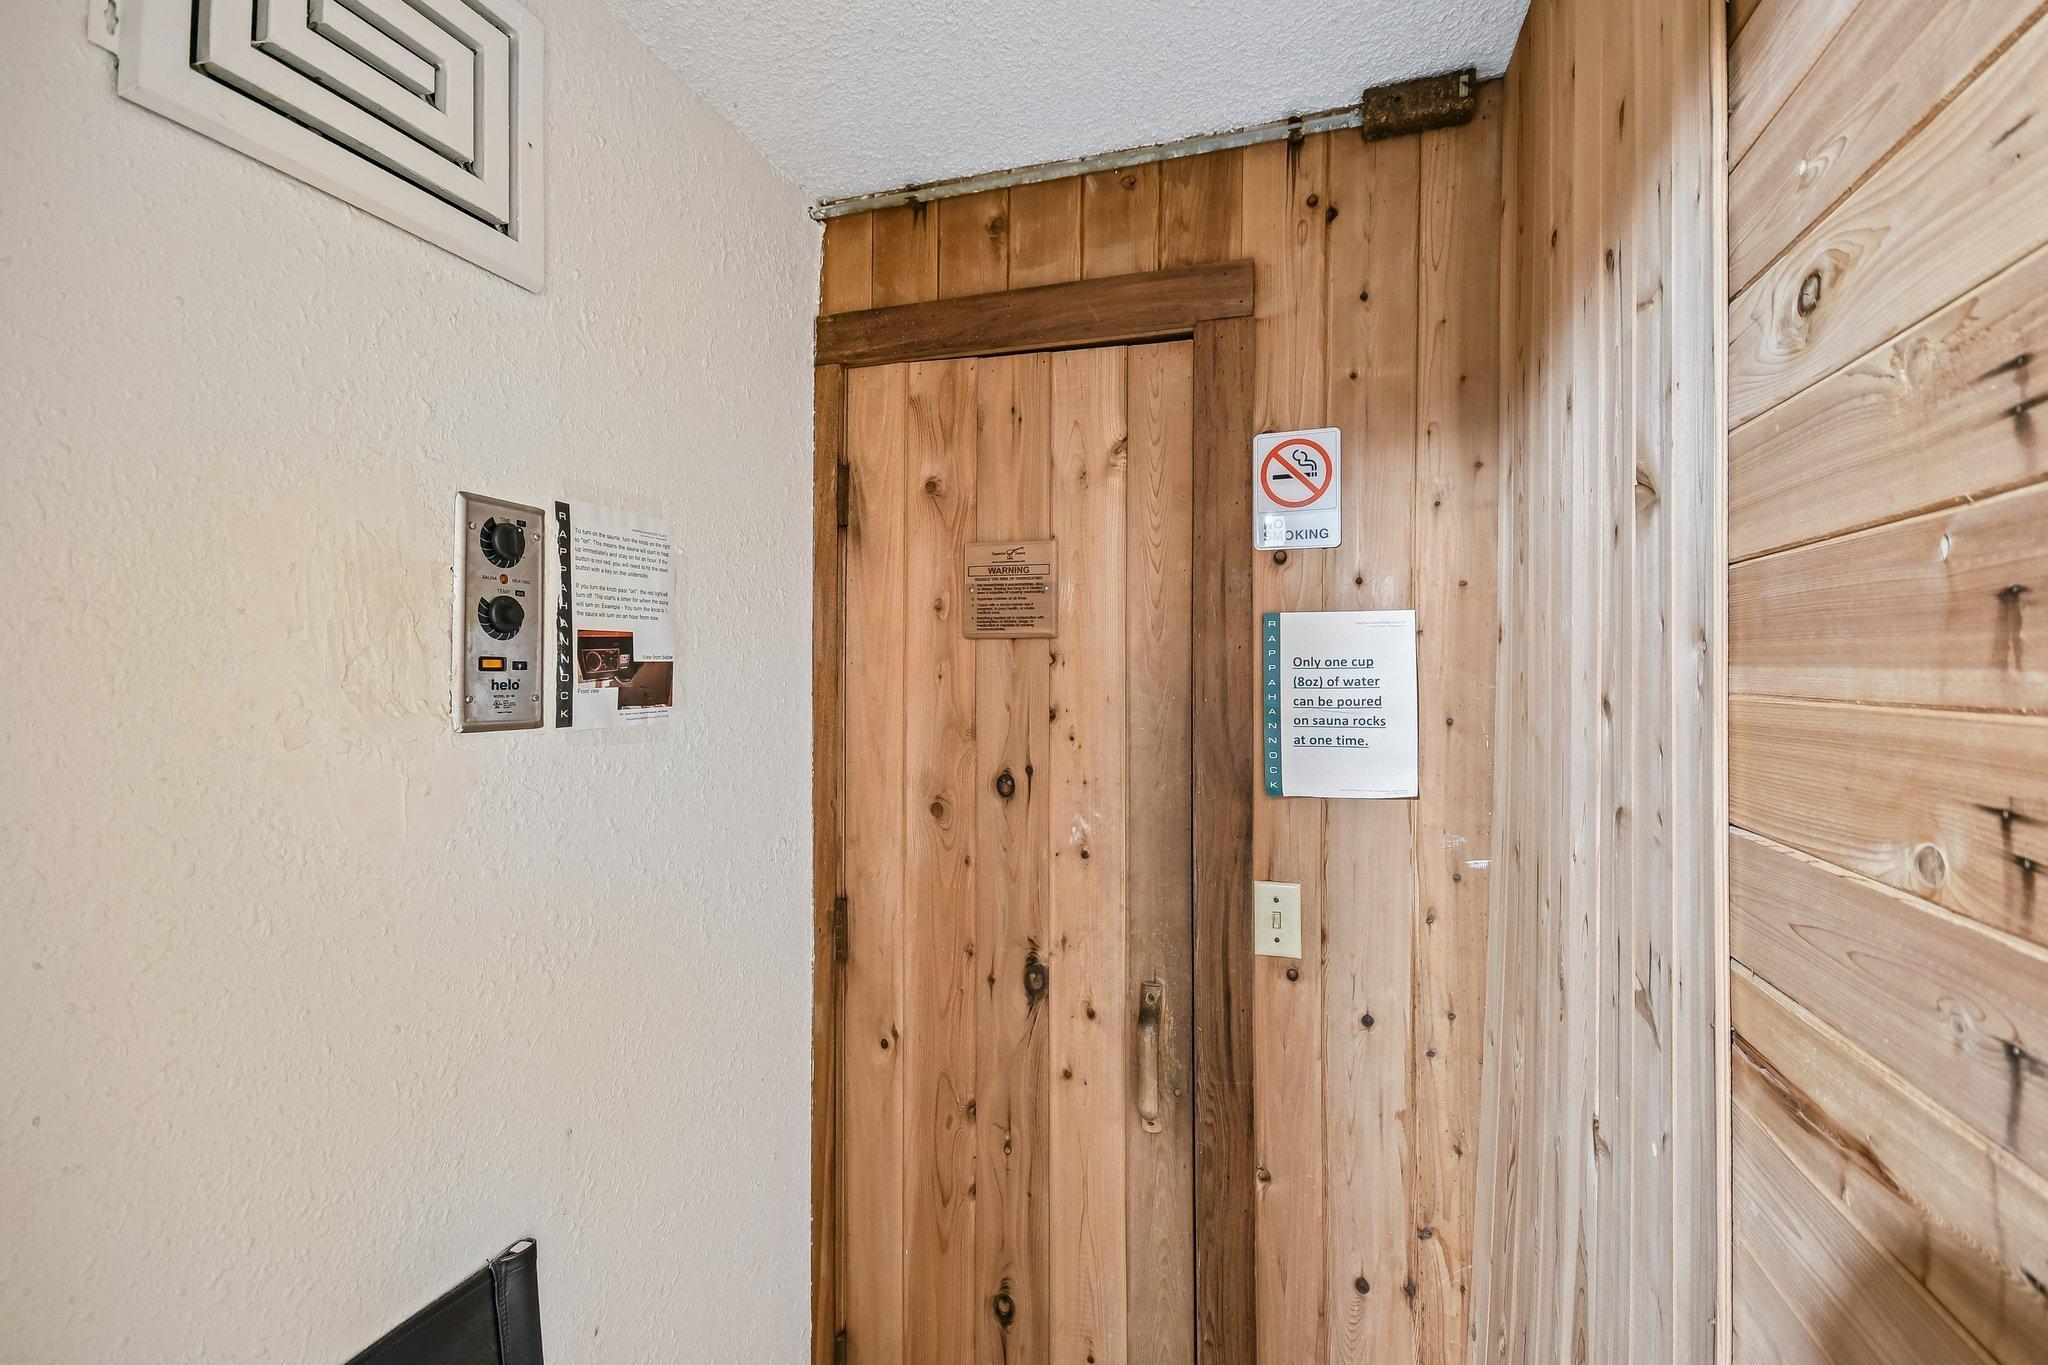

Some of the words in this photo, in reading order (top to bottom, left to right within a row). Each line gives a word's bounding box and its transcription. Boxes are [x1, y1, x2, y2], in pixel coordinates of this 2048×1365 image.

[583, 548, 608, 557] immediately
[1293, 657, 1321, 669] Only
[1325, 659, 1348, 667] one
[1352, 659, 1374, 668] cup
[491, 679, 519, 690] helo
[1293, 676, 1323, 688] (8oz)
[1327, 676, 1340, 687] of
[1343, 677, 1380, 687] water
[1268, 620, 1278, 789] RAPPAHANNOCK
[1293, 698, 1314, 707] can
[1318, 696, 1333, 707] be
[1337, 696, 1382, 708] poured
[1293, 718, 1309, 726] on
[1313, 718, 1349, 726] sauna
[1352, 716, 1386, 727] rocks
[1294, 737, 1306, 746] at
[1309, 737, 1332, 746] one
[1336, 736, 1369, 746] time.
